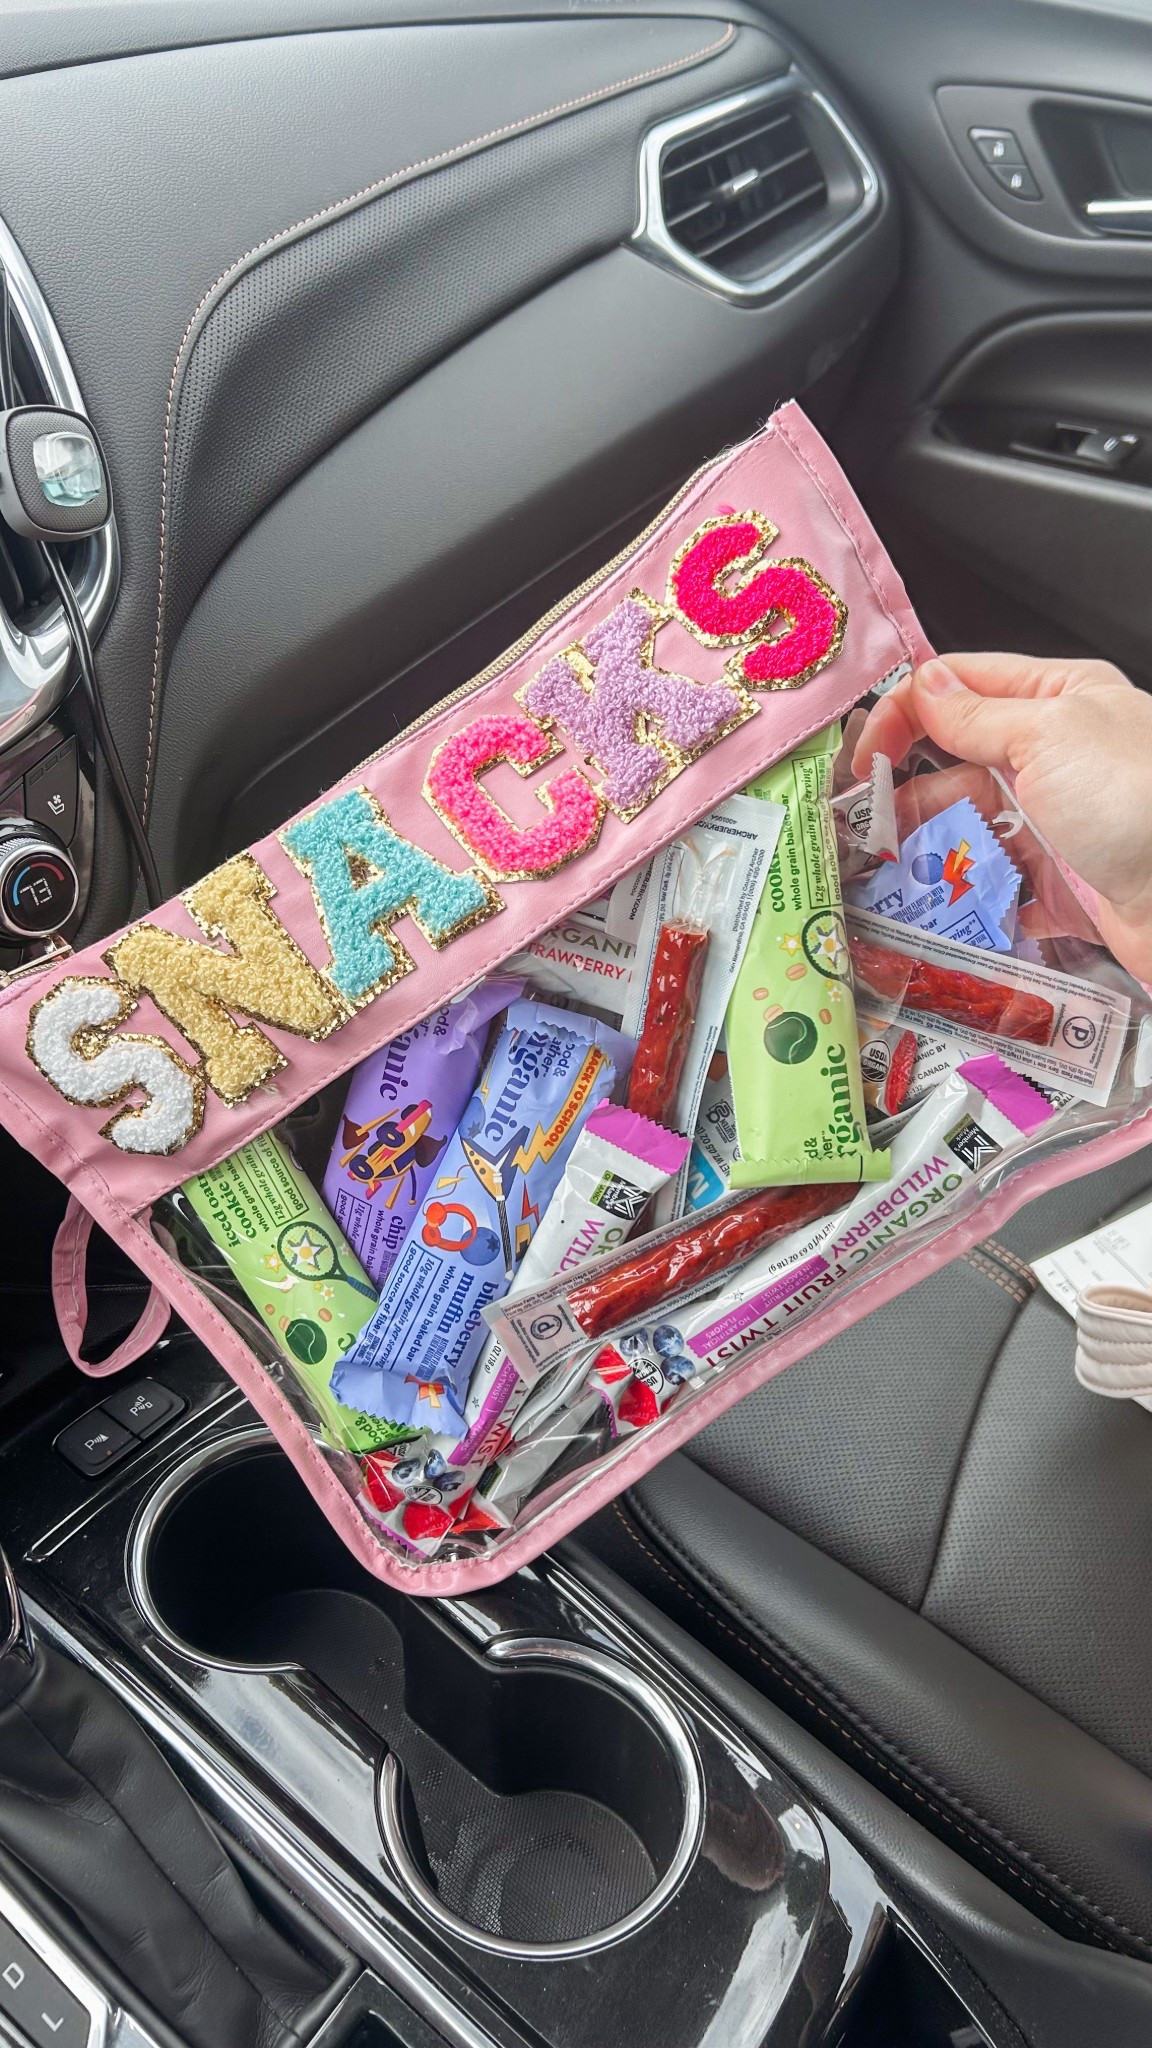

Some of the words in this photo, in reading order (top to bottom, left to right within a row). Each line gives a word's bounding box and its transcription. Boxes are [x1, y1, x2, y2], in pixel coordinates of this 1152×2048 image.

[25, 509, 850, 1156] SNACKS
[742, 867, 753, 892] Country
[749, 847, 758, 867] Archer
[789, 855, 800, 878] grain
[20, 877, 53, 906] 73
[790, 880, 801, 911] whole
[1068, 1025, 1089, 1042] P
[936, 1043, 947, 1054] BY
[582, 1048, 603, 1082] BACK
[917, 1061, 951, 1081] CANADA
[573, 1082, 588, 1101] TO
[543, 1100, 579, 1147] SCHOOL
[718, 1118, 736, 1139] GLUTEN
[251, 1156, 267, 1182] grain
[272, 1160, 293, 1190] source
[238, 1184, 257, 1211] grain
[261, 1180, 279, 1204] whole
[289, 1188, 305, 1212] good
[219, 1181, 257, 1239] cookie
[253, 1206, 270, 1233] whole
[272, 1201, 286, 1221] 12g
[832, 1155, 950, 1260] WILDBERRY
[850, 1173, 963, 1265] ORGANIC
[212, 1206, 242, 1248] iced
[382, 1215, 406, 1250] chip
[404, 1247, 417, 1273] good
[552, 1219, 605, 1277] WILD
[787, 1252, 799, 1263] OZ
[797, 1241, 814, 1257] 0.63
[387, 1273, 407, 1304] source
[411, 1275, 426, 1300] whole
[440, 1266, 456, 1293] whole
[759, 1281, 785, 1301] TWIST
[782, 1270, 802, 1285] EACH
[782, 1263, 847, 1317] FRUIT
[793, 1273, 810, 1287] CUP
[400, 1297, 416, 1328] grain
[427, 1294, 442, 1321] grain
[437, 1271, 475, 1335] muffin
[763, 1291, 784, 1308] FRUIT
[414, 1315, 434, 1346] baked
[444, 1280, 500, 1369] blueberry
[704, 1315, 737, 1339] FLAVORS
[737, 1314, 751, 1327] NO
[700, 1322, 739, 1351] ARTIFICIAL
[405, 1342, 420, 1362] bar
[490, 1377, 506, 1400] TWIST
[471, 1404, 519, 1467] TWIST
[2, 1961, 25, 1990] D
[41, 2012, 64, 2033] L
